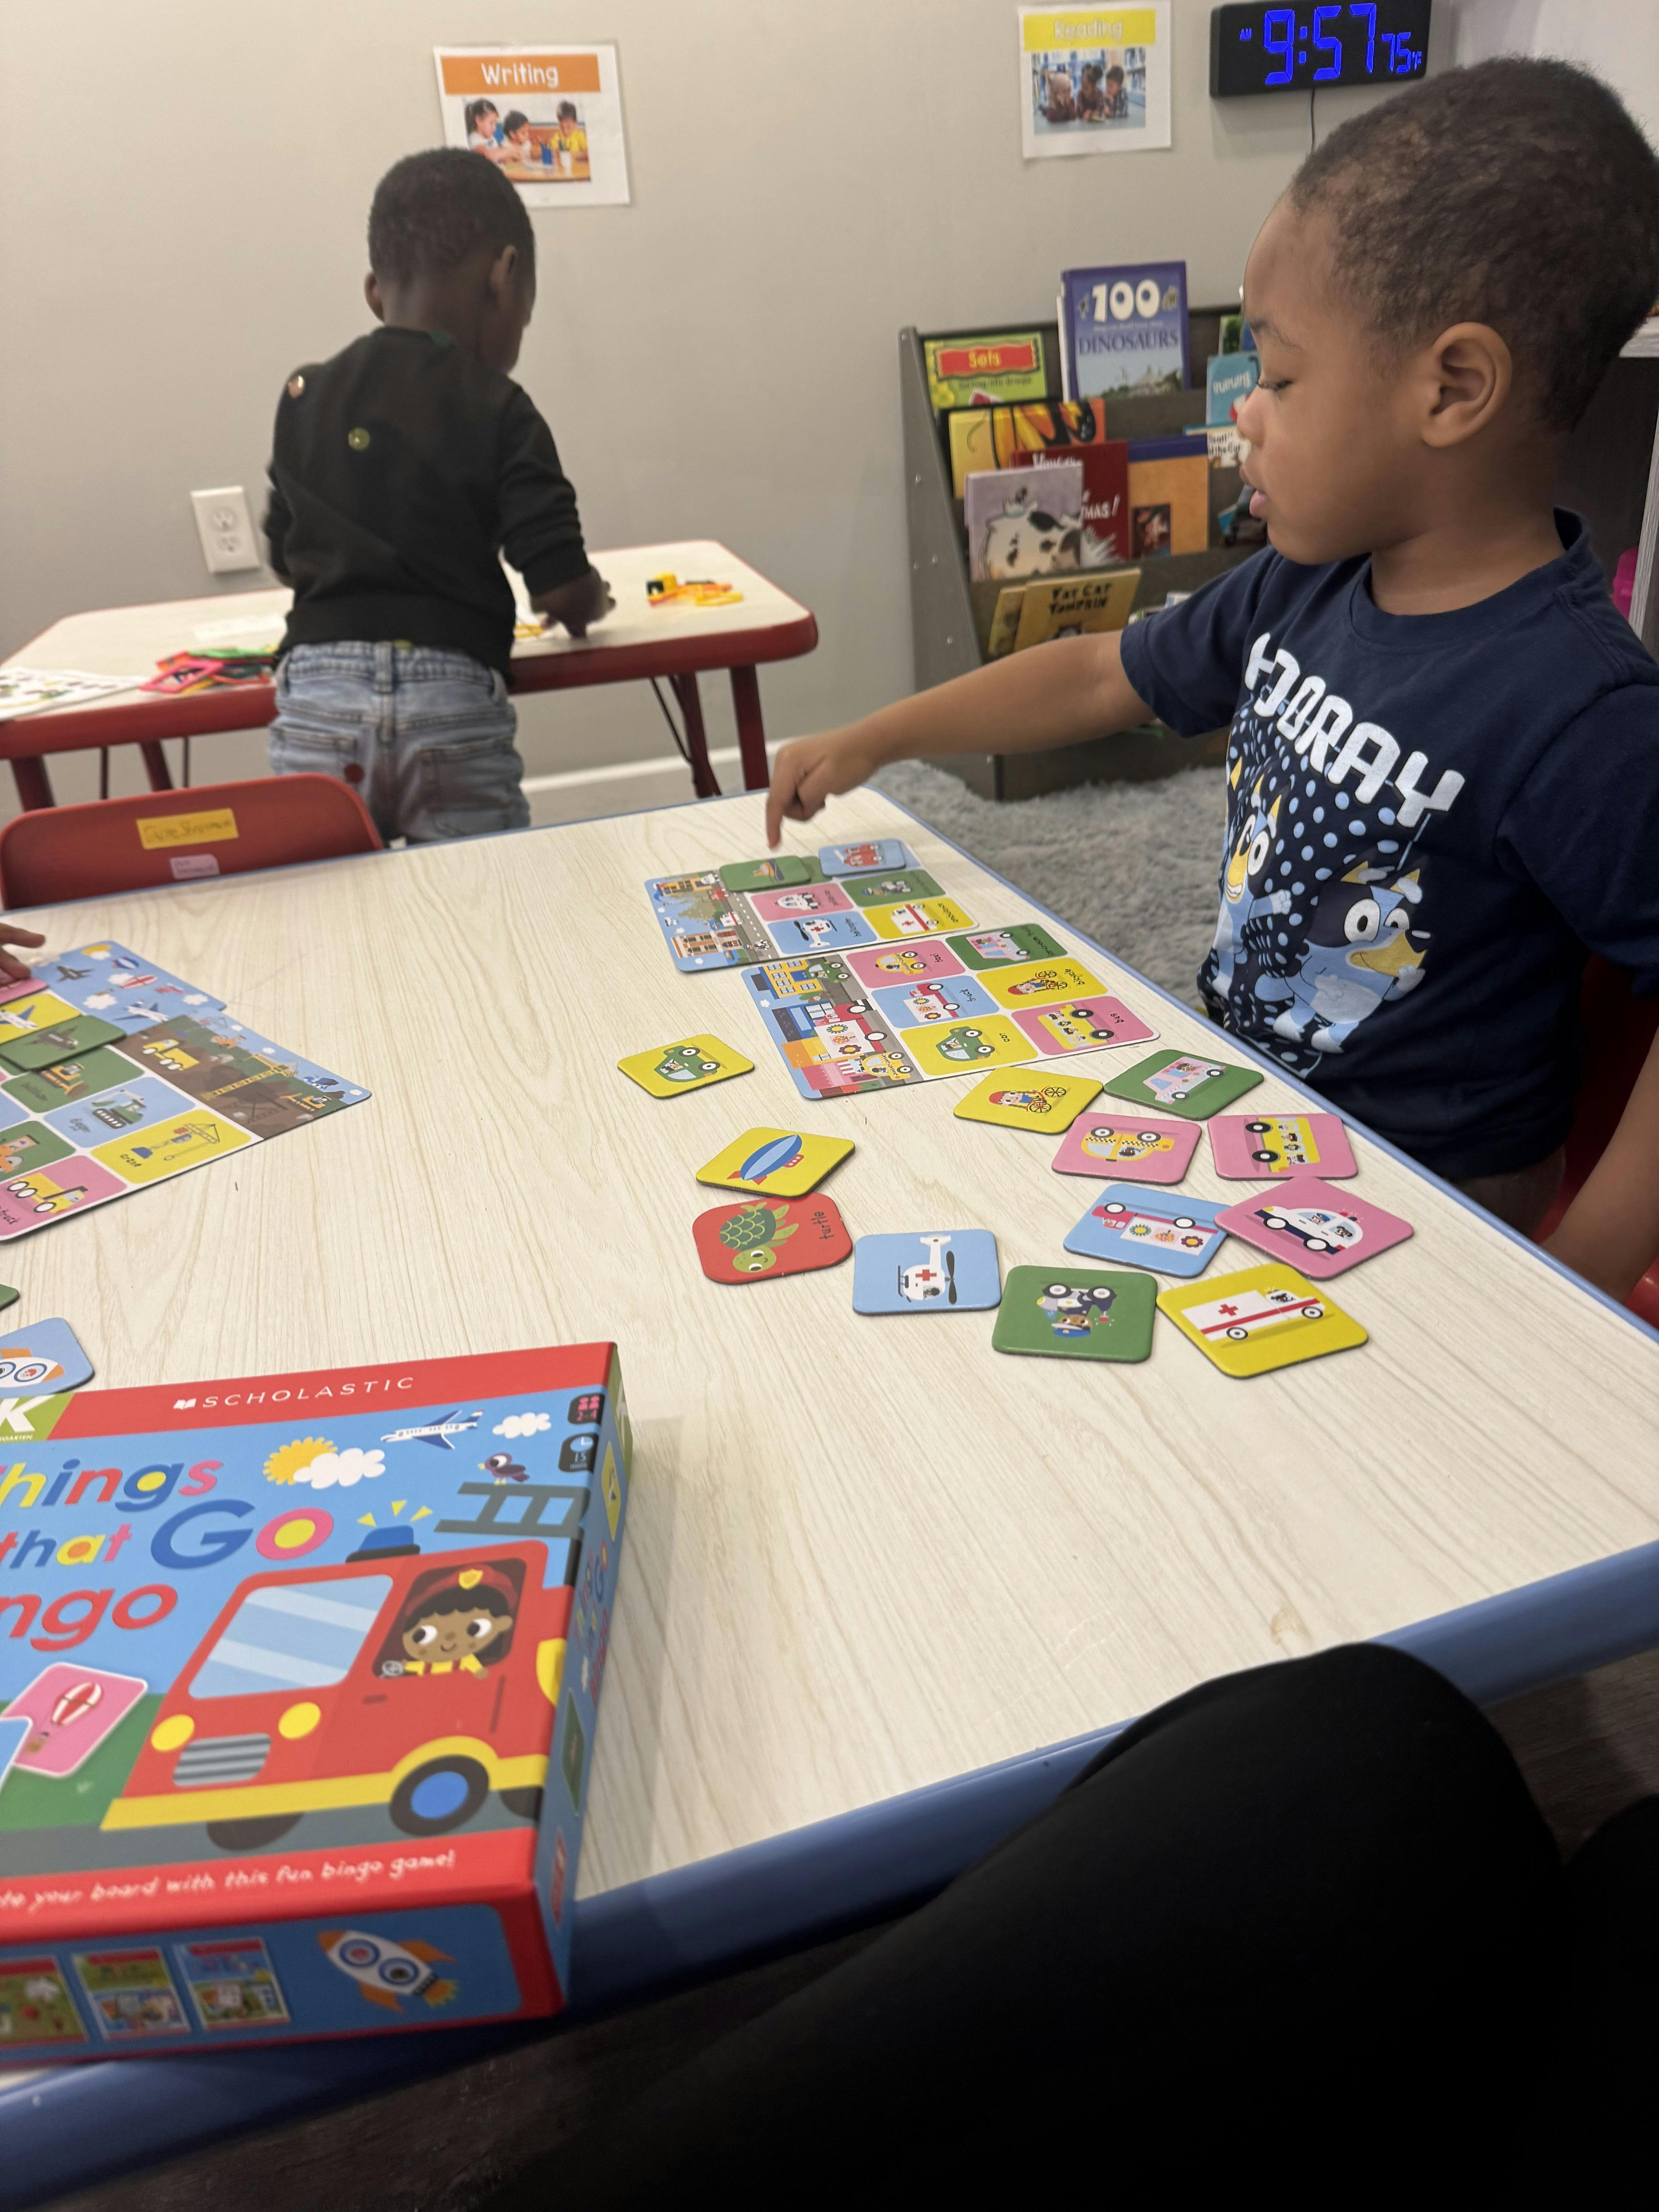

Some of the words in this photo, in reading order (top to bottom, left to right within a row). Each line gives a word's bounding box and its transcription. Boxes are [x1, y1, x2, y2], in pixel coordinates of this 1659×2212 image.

[1054, 18, 1122, 40] Reading
[1263, 3, 1376, 84] 9:57
[481, 63, 559, 88] Writing
[1092, 279, 1160, 322] 100
[1079, 330, 1178, 355] DINOSAURS
[930, 953, 943, 963] taxi
[1111, 1013, 1124, 1024] bus
[1000, 1033, 1010, 1042] car
[120, 1154, 142, 1167] crane
[811, 1211, 835, 1240] turtle
[203, 1377, 414, 1408] SCHOLASTIC
[0, 1458, 223, 1512] hings
[28, 1890, 83, 1914] your
[89, 1876, 160, 1901] board
[166, 1872, 215, 1894] with
[224, 1869, 269, 1889] this
[276, 1865, 313, 1884] fun
[321, 1860, 384, 1884] bingo
[388, 1849, 456, 1879] game!
